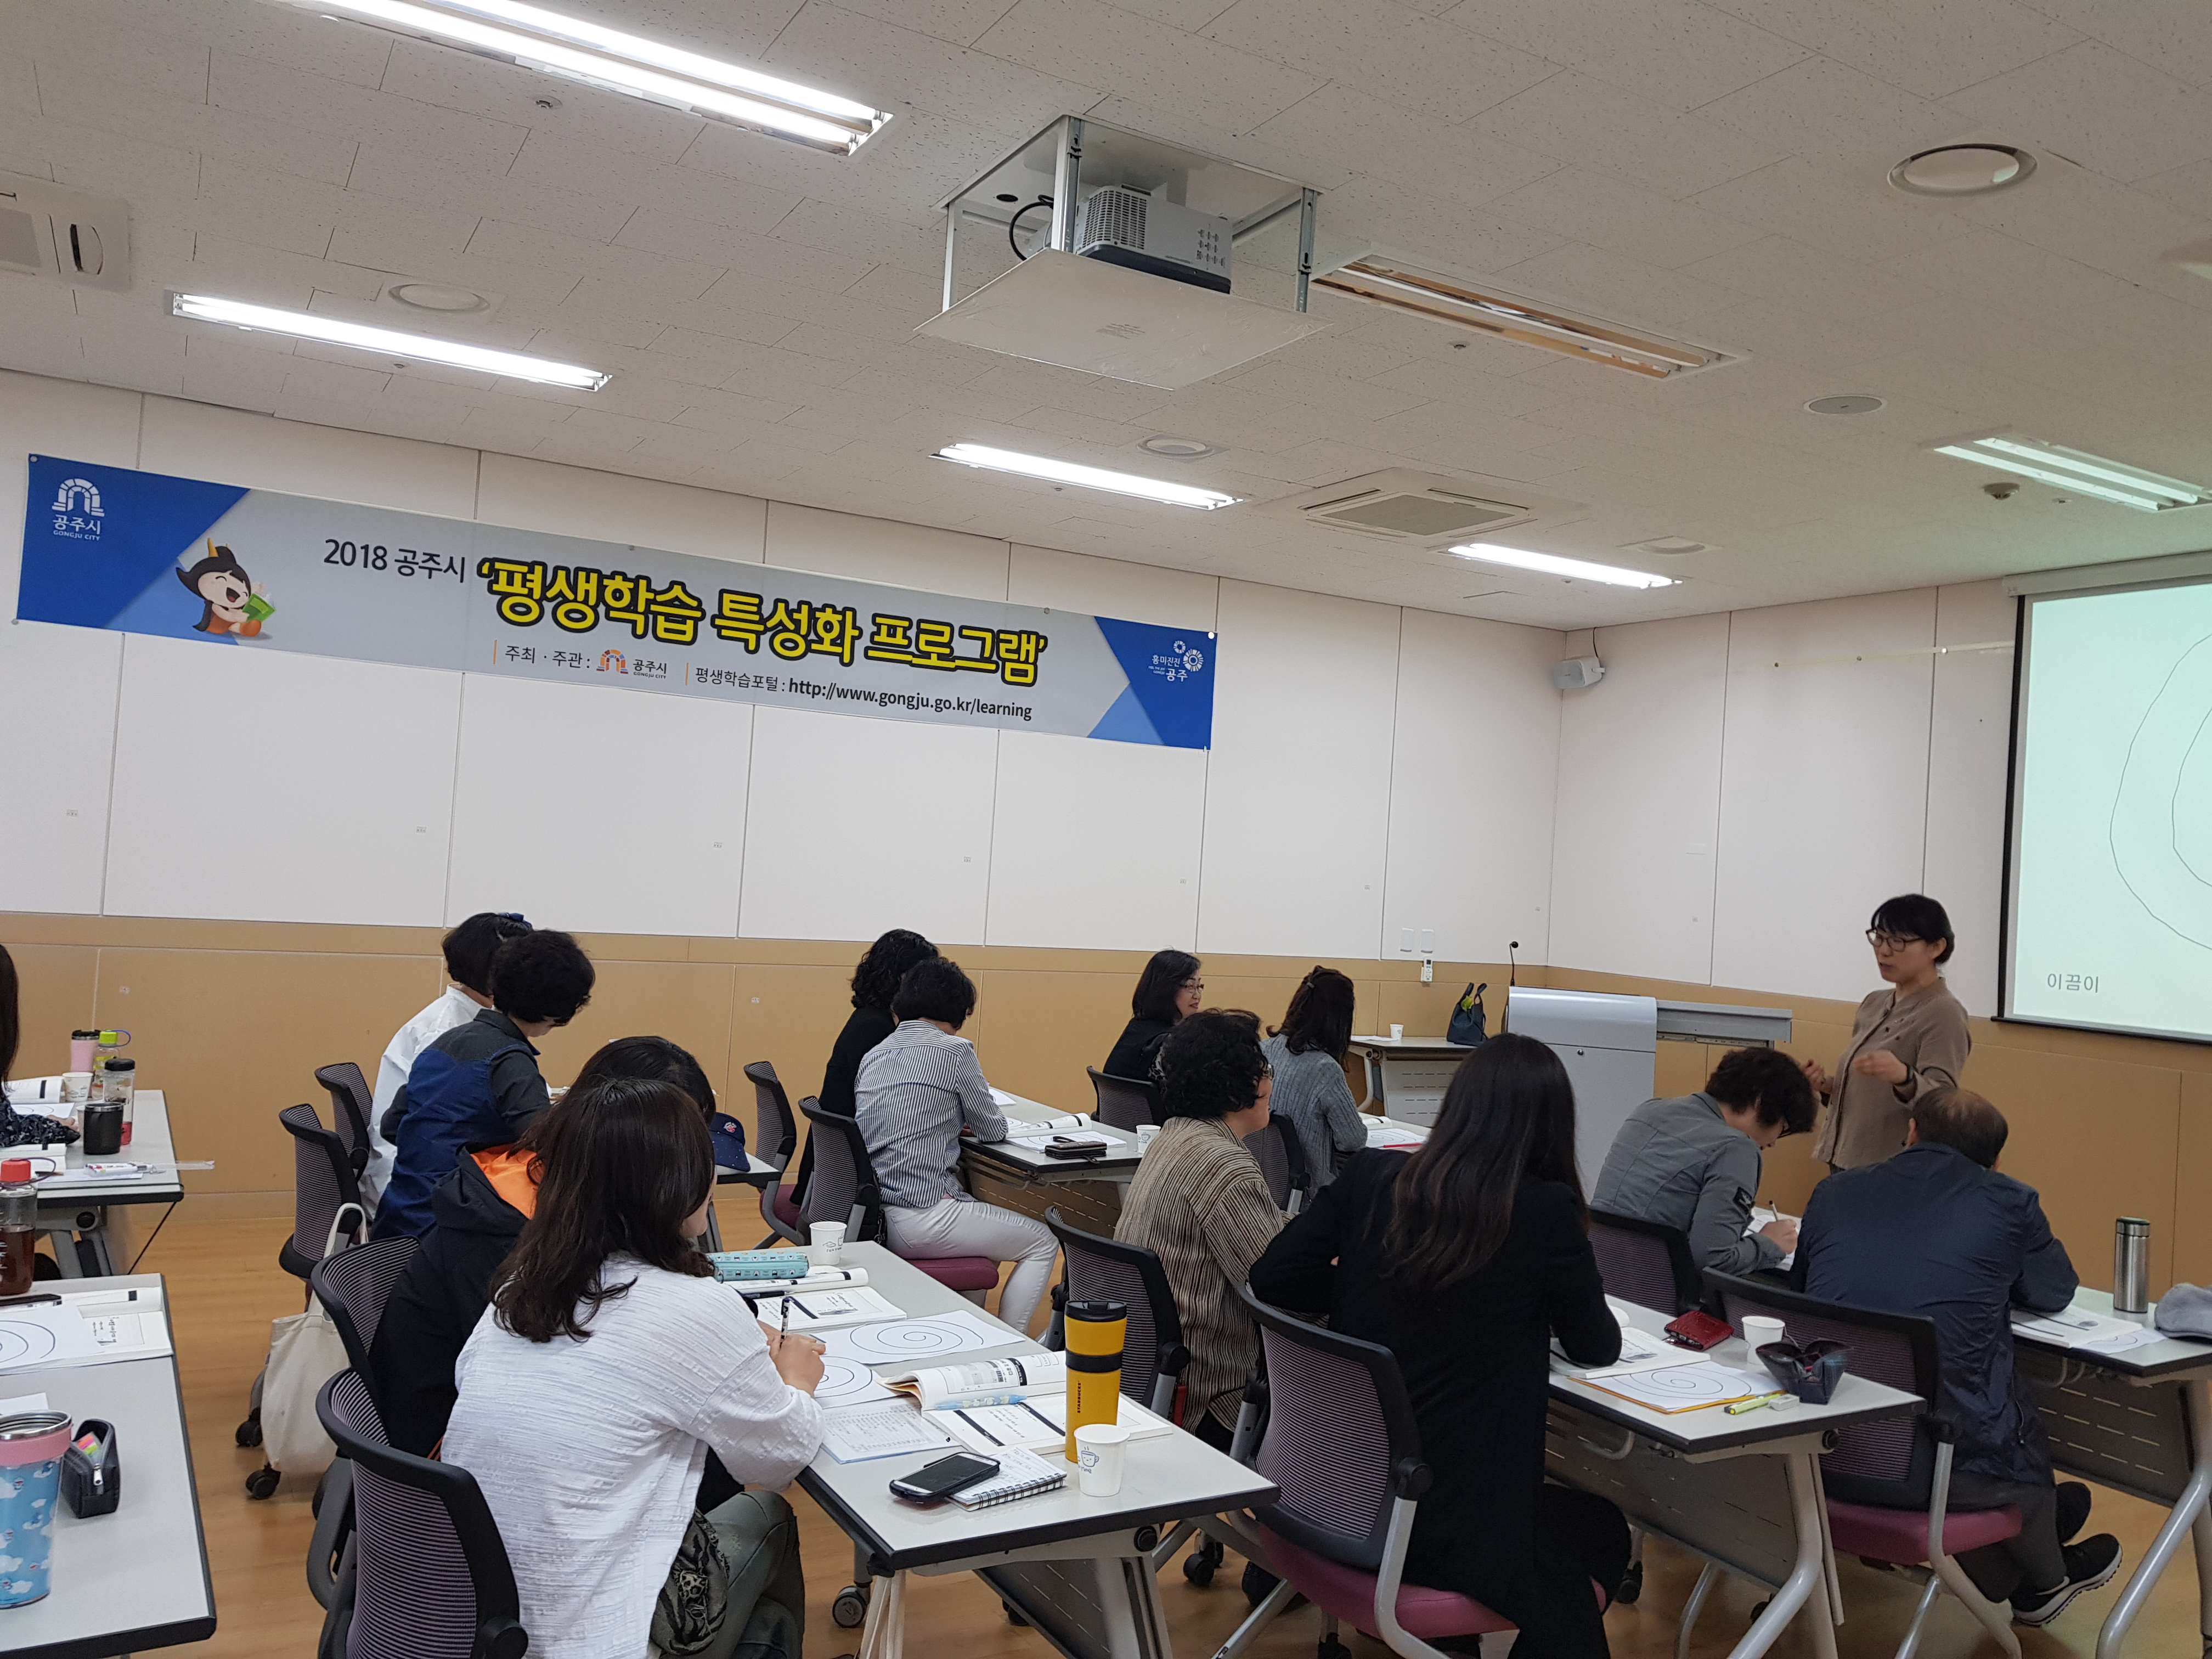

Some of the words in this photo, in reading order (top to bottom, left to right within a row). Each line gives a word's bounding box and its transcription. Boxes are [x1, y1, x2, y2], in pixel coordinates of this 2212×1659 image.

[53, 514, 101, 535] 공주시
[53, 530, 82, 539] GONGJU
[324, 539, 387, 570] 2018
[394, 549, 465, 583] 공주시
[710, 589, 863, 667] 특성화
[505, 645, 535, 664] 주최
[1152, 654, 1180, 667] 흥미진진
[633, 659, 667, 674] 공주시
[1166, 668, 1188, 682] 공주
[789, 678, 1032, 721] http://www.gongju.go.kr/learning
[2047, 973, 2098, 993] 이끔이
